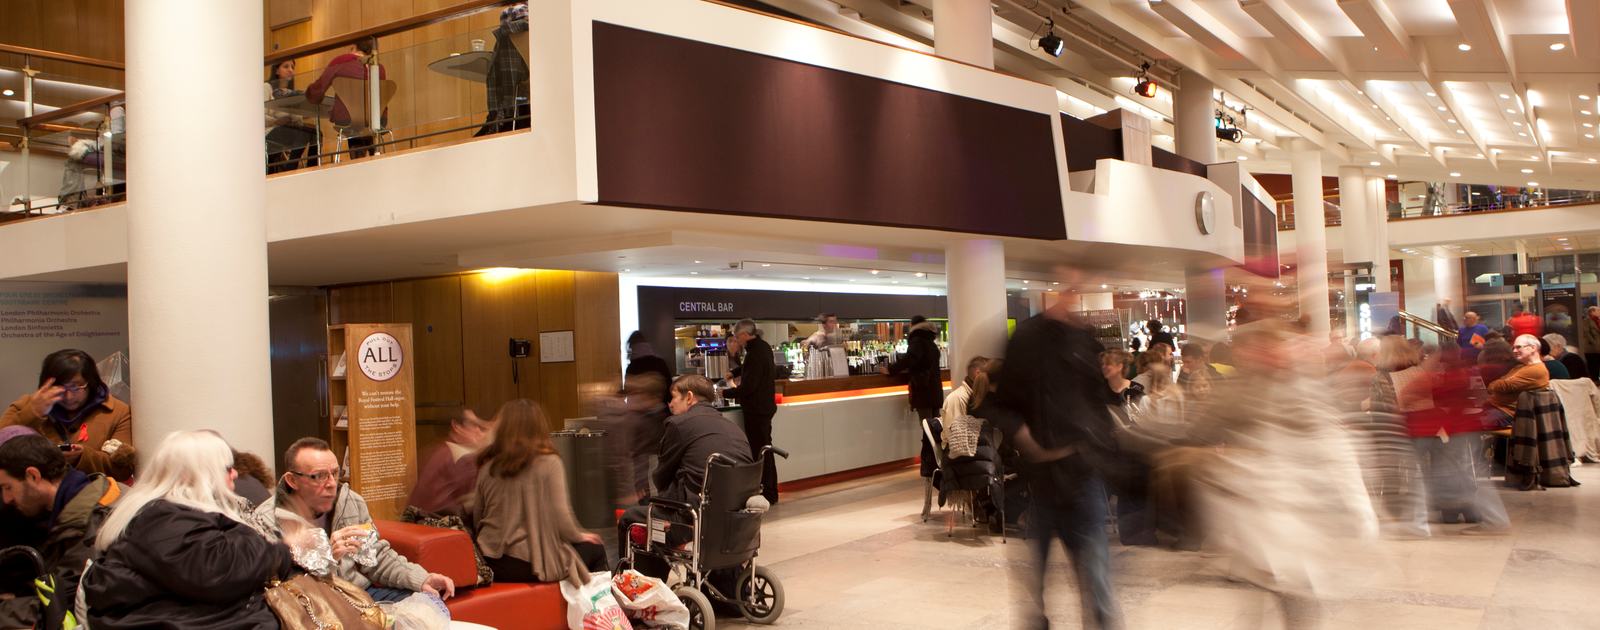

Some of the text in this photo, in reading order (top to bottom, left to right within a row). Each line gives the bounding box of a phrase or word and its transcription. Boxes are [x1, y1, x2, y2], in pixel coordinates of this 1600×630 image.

[680, 301, 734, 312] CENTRAL BAR
[363, 347, 398, 363] ALL
[365, 364, 398, 377] THE STOPS
